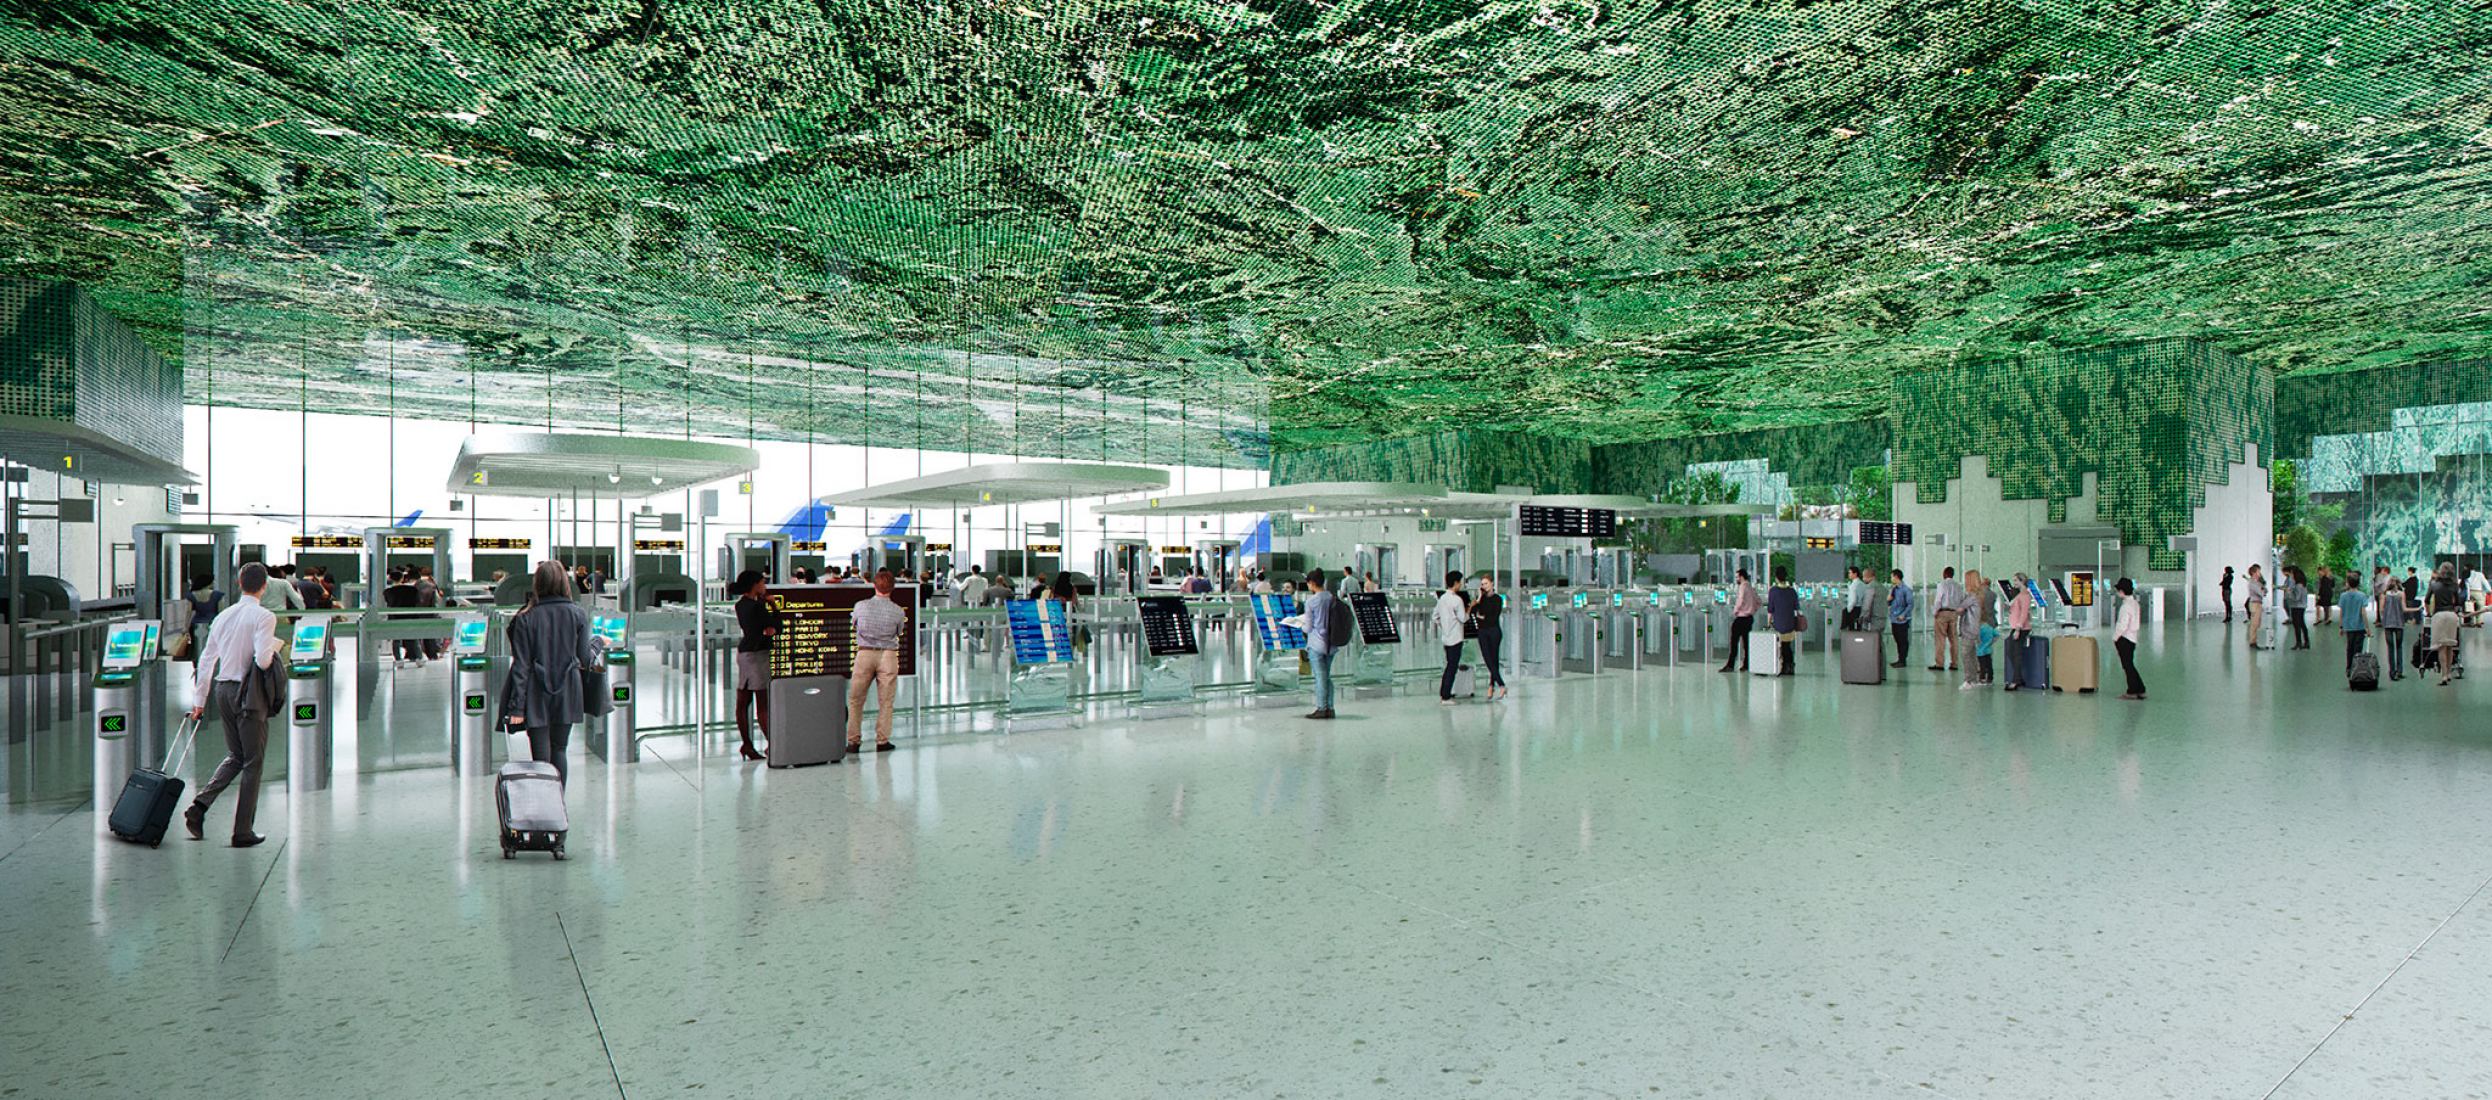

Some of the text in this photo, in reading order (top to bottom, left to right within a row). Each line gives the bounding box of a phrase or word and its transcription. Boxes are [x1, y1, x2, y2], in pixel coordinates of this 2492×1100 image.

[63, 456, 72, 469] 1
[473, 471, 483, 484] 2
[743, 483, 751, 492] 3
